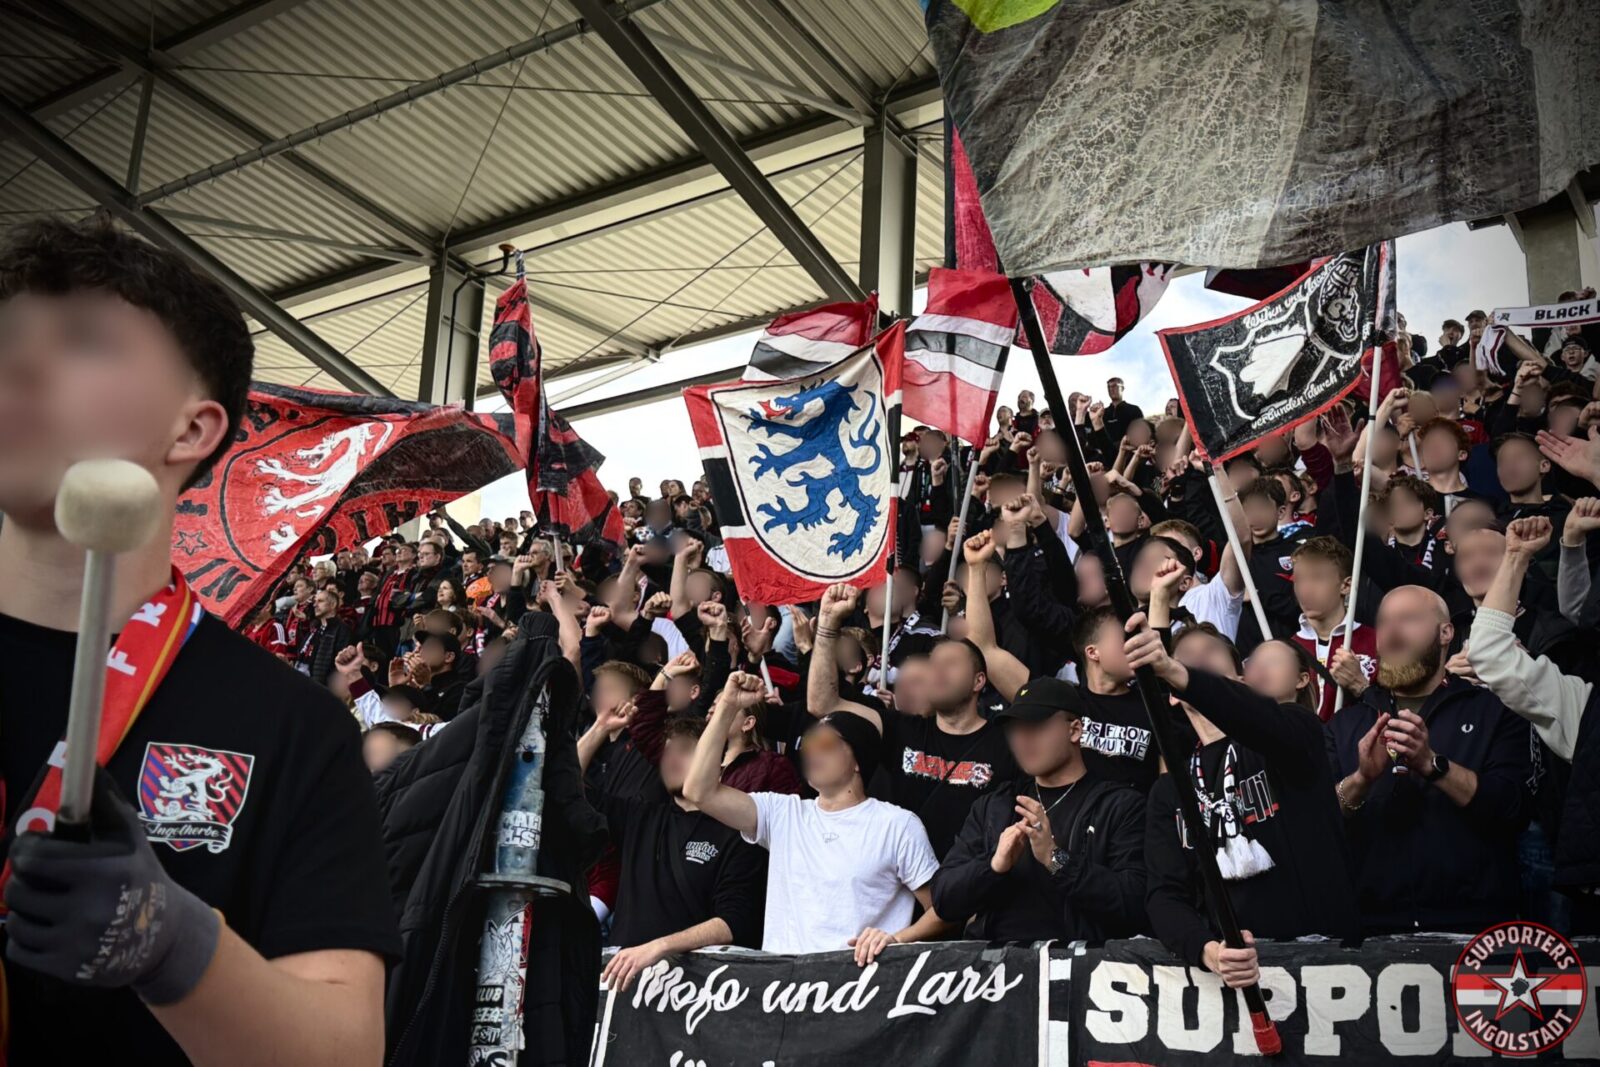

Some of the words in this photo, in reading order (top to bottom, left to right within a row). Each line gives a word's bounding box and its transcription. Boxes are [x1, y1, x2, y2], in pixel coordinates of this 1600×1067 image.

[1534, 303, 1590, 320] BLACK
[1306, 371, 1338, 399] durch
[1105, 723, 1151, 745] FROM
[762, 961, 880, 1014] und
[886, 950, 1024, 1019] Lars
